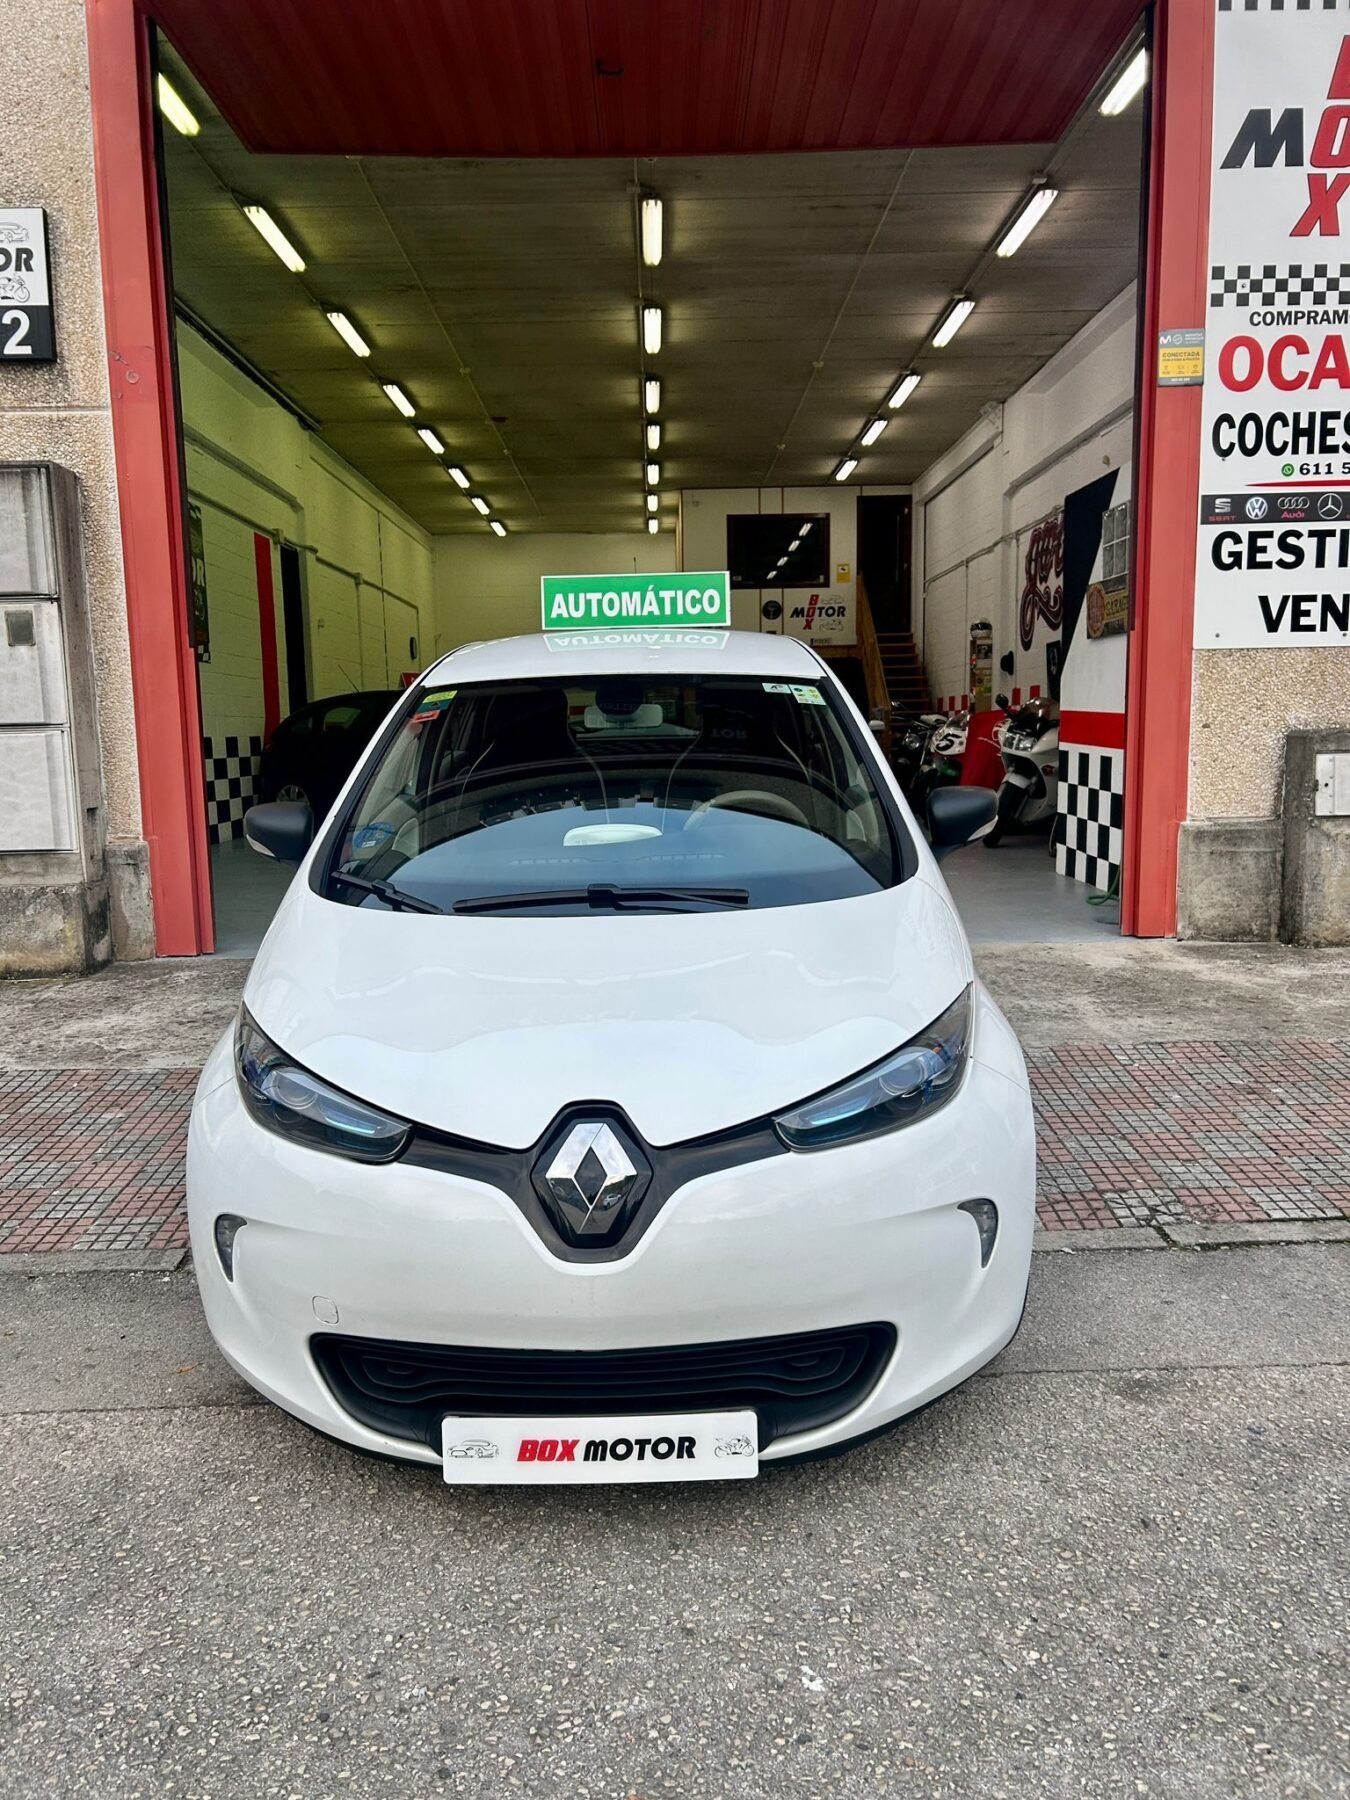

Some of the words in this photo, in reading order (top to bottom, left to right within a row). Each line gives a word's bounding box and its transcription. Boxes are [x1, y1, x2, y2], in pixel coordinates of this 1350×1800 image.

[1249, 309, 1350, 327] COMPRAM
[2, 309, 33, 355] 2
[1299, 463, 1334, 476] 611
[1208, 514, 1237, 522] SEAT
[1281, 510, 1305, 519] Audi
[1211, 528, 1350, 572] GESTI
[550, 584, 721, 619] AUTOMÁTICO
[1257, 593, 1350, 633] VEN
[516, 1438, 581, 1462] BOX
[583, 1436, 697, 1462] MOTOR
